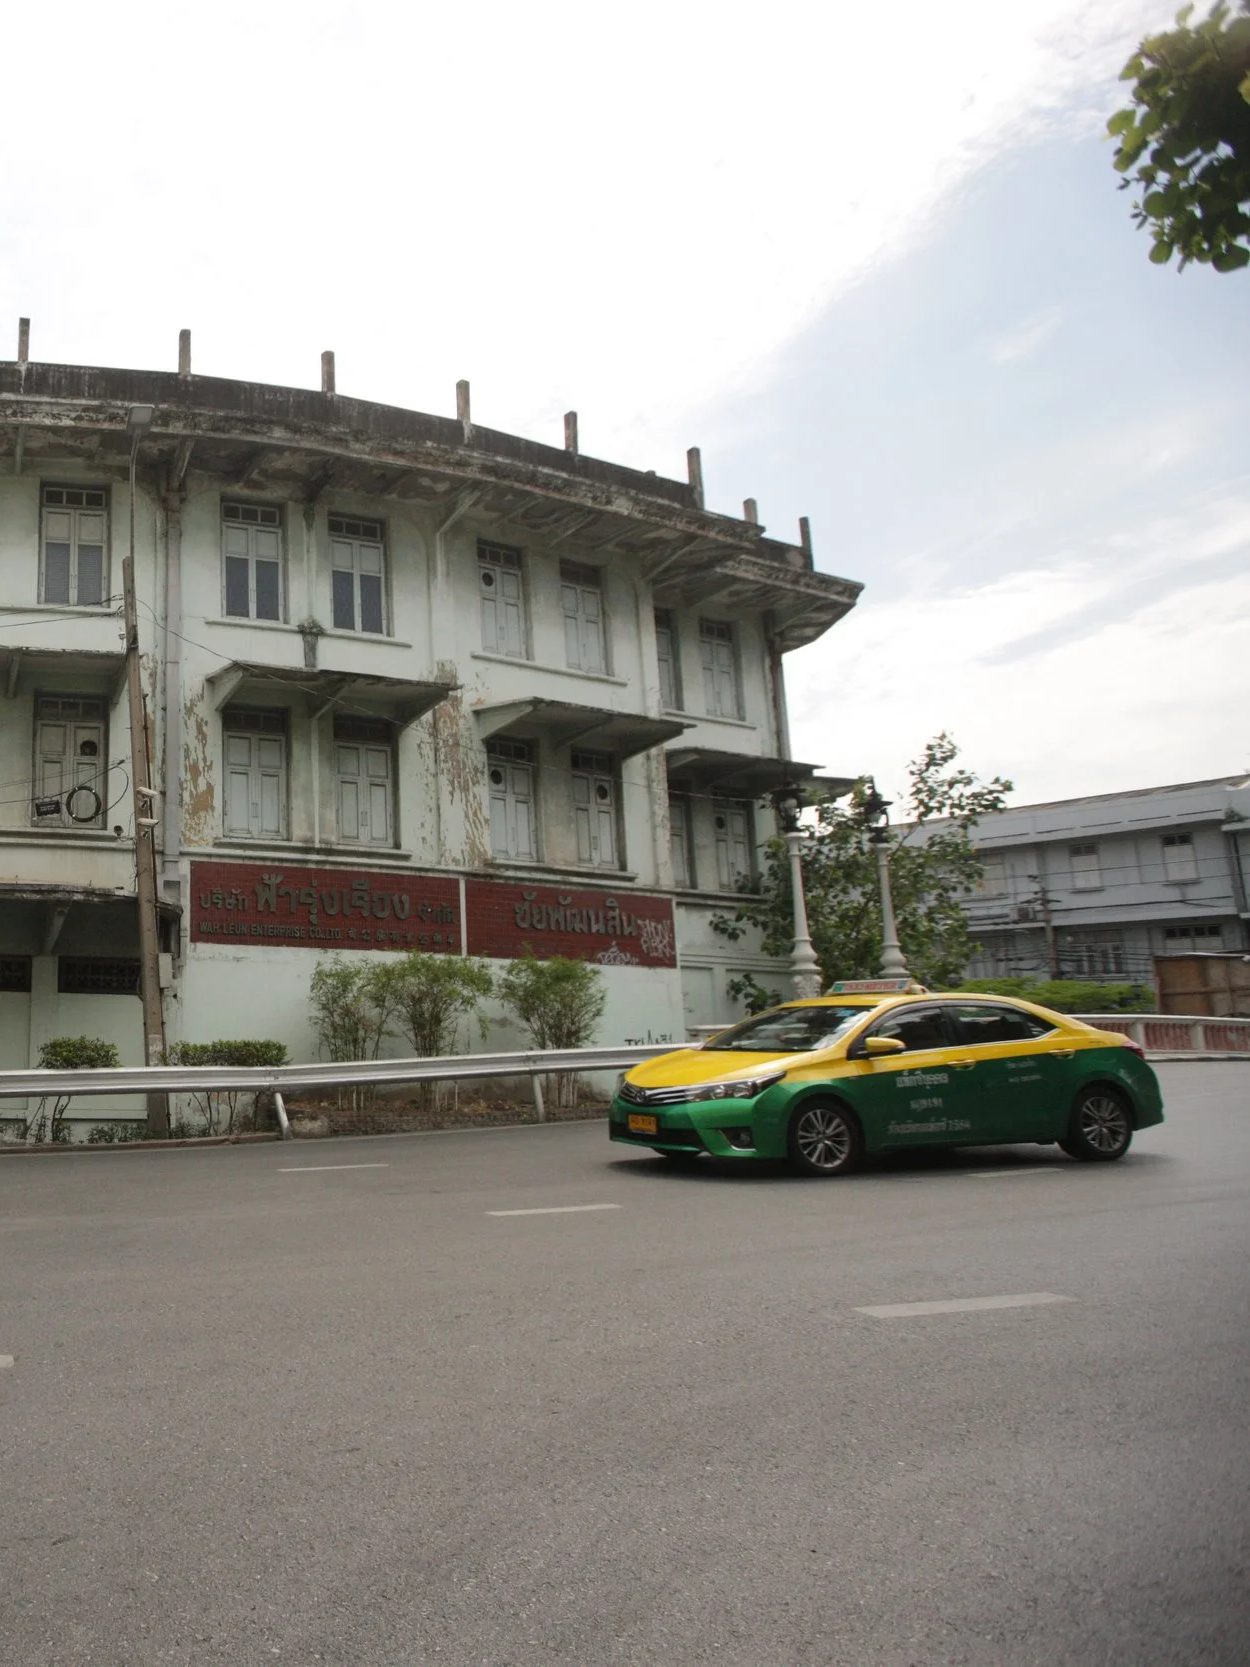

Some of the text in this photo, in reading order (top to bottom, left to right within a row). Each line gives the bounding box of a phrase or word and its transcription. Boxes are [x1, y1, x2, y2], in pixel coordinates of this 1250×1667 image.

[200, 888, 248, 910] บริษัท
[254, 872, 410, 925] ฟ้ารุ่งเรือง
[251, 923, 305, 939] ENTERPRISE
